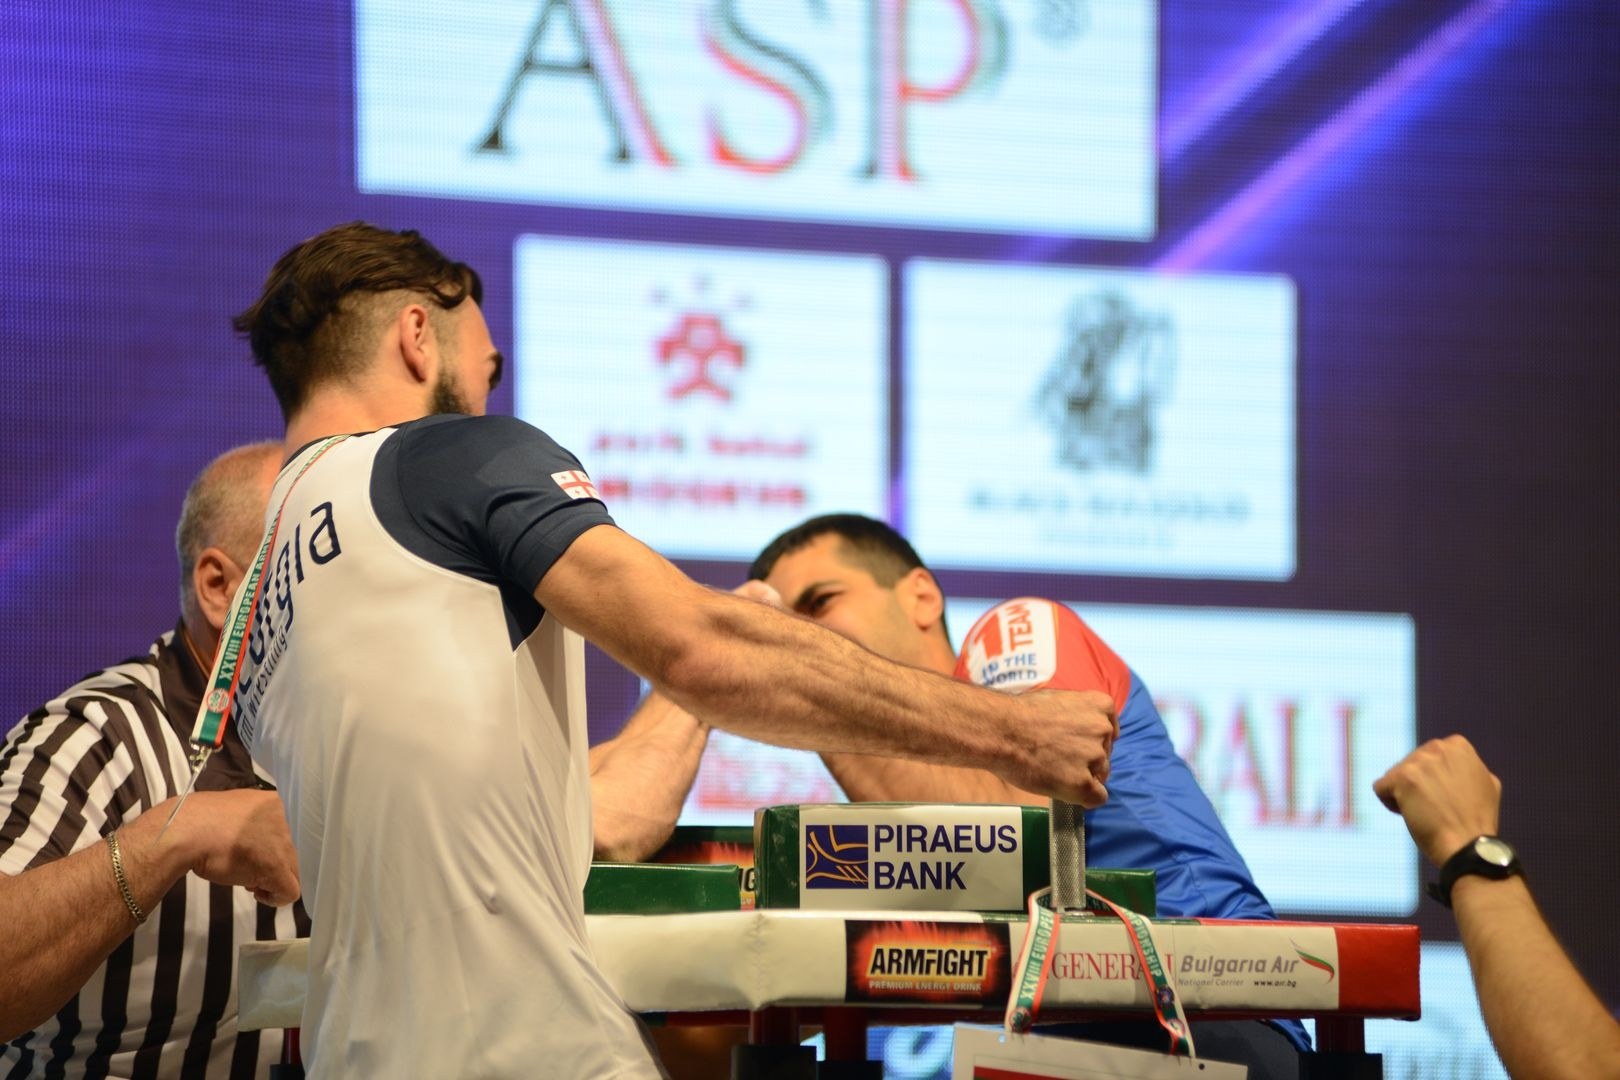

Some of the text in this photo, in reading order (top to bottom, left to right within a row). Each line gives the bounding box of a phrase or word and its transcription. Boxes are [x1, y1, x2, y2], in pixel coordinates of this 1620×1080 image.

[467, 0, 1013, 182] ASP
[1006, 603, 1034, 651] TEAM
[1003, 653, 1037, 668] THE
[874, 824, 1018, 853] PIRAEUS
[874, 861, 967, 890] BANK
[870, 947, 988, 977] ARMFIGHT
[1181, 955, 1299, 977] Bulgaria Air
[869, 980, 982, 992] PREMIUM ENERGY DRINK
[1254, 979, 1297, 988] www.air.bg
